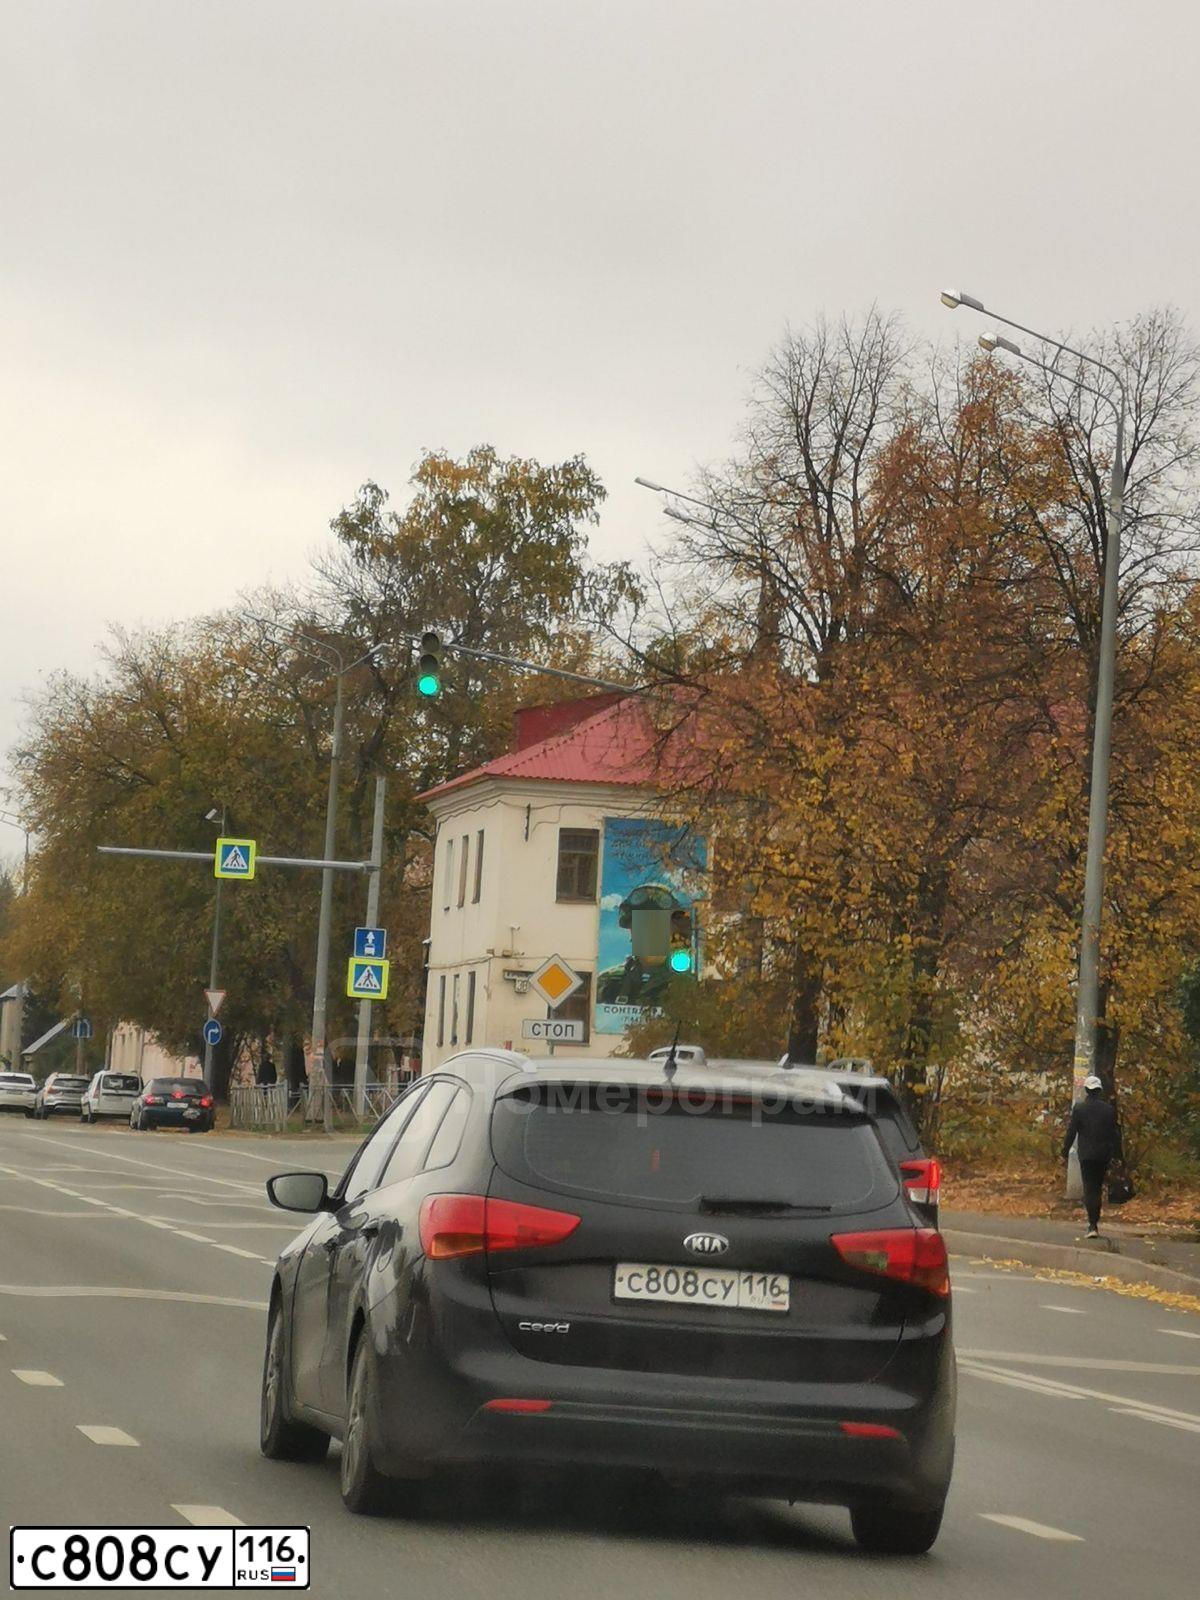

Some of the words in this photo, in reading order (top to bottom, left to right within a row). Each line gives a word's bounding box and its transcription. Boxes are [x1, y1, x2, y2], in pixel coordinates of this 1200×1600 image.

[531, 1023, 575, 1037] СТОП
[691, 1237, 722, 1251] KIA
[742, 1274, 781, 1297] 116
